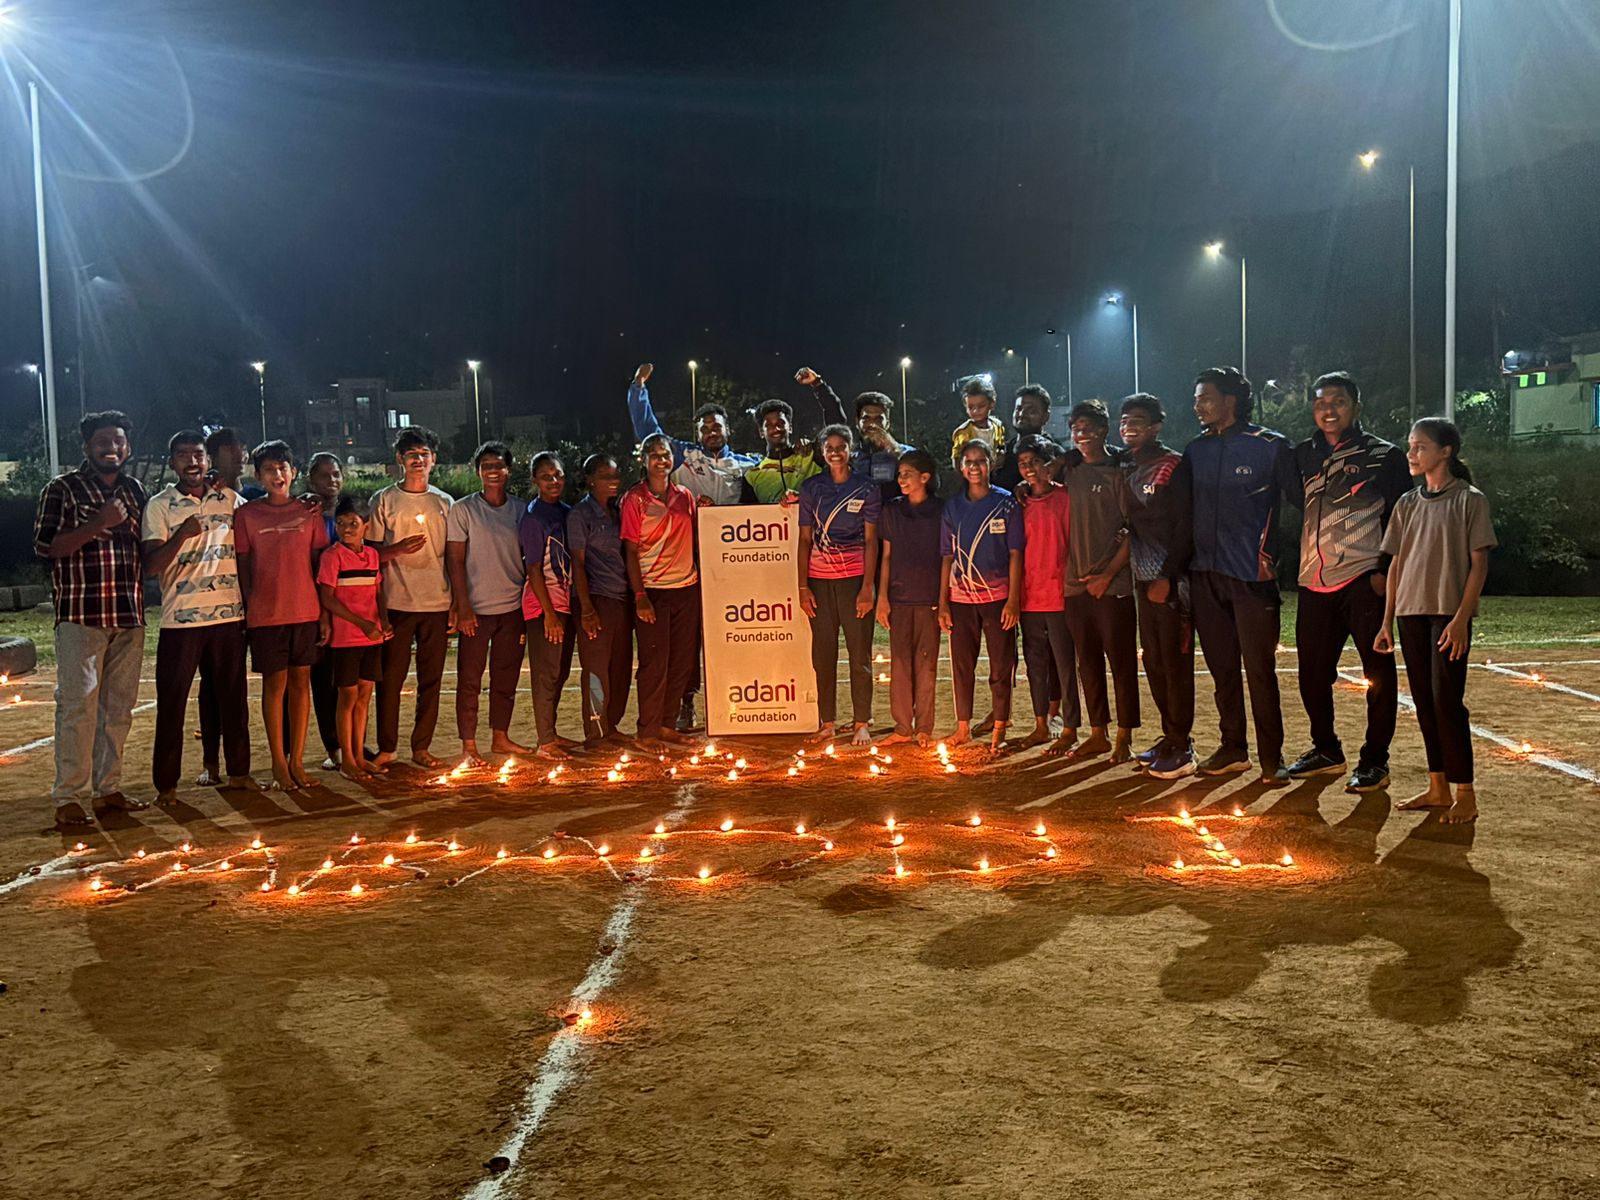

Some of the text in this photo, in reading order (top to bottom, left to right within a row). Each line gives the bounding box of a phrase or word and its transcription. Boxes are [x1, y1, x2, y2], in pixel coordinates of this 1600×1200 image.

[720, 517, 789, 543] adani
[722, 551, 790, 563] Foundation
[725, 598, 793, 623] adani
[726, 631, 793, 643] Foundation
[729, 679, 796, 704] adani
[730, 711, 797, 723] Foundation
